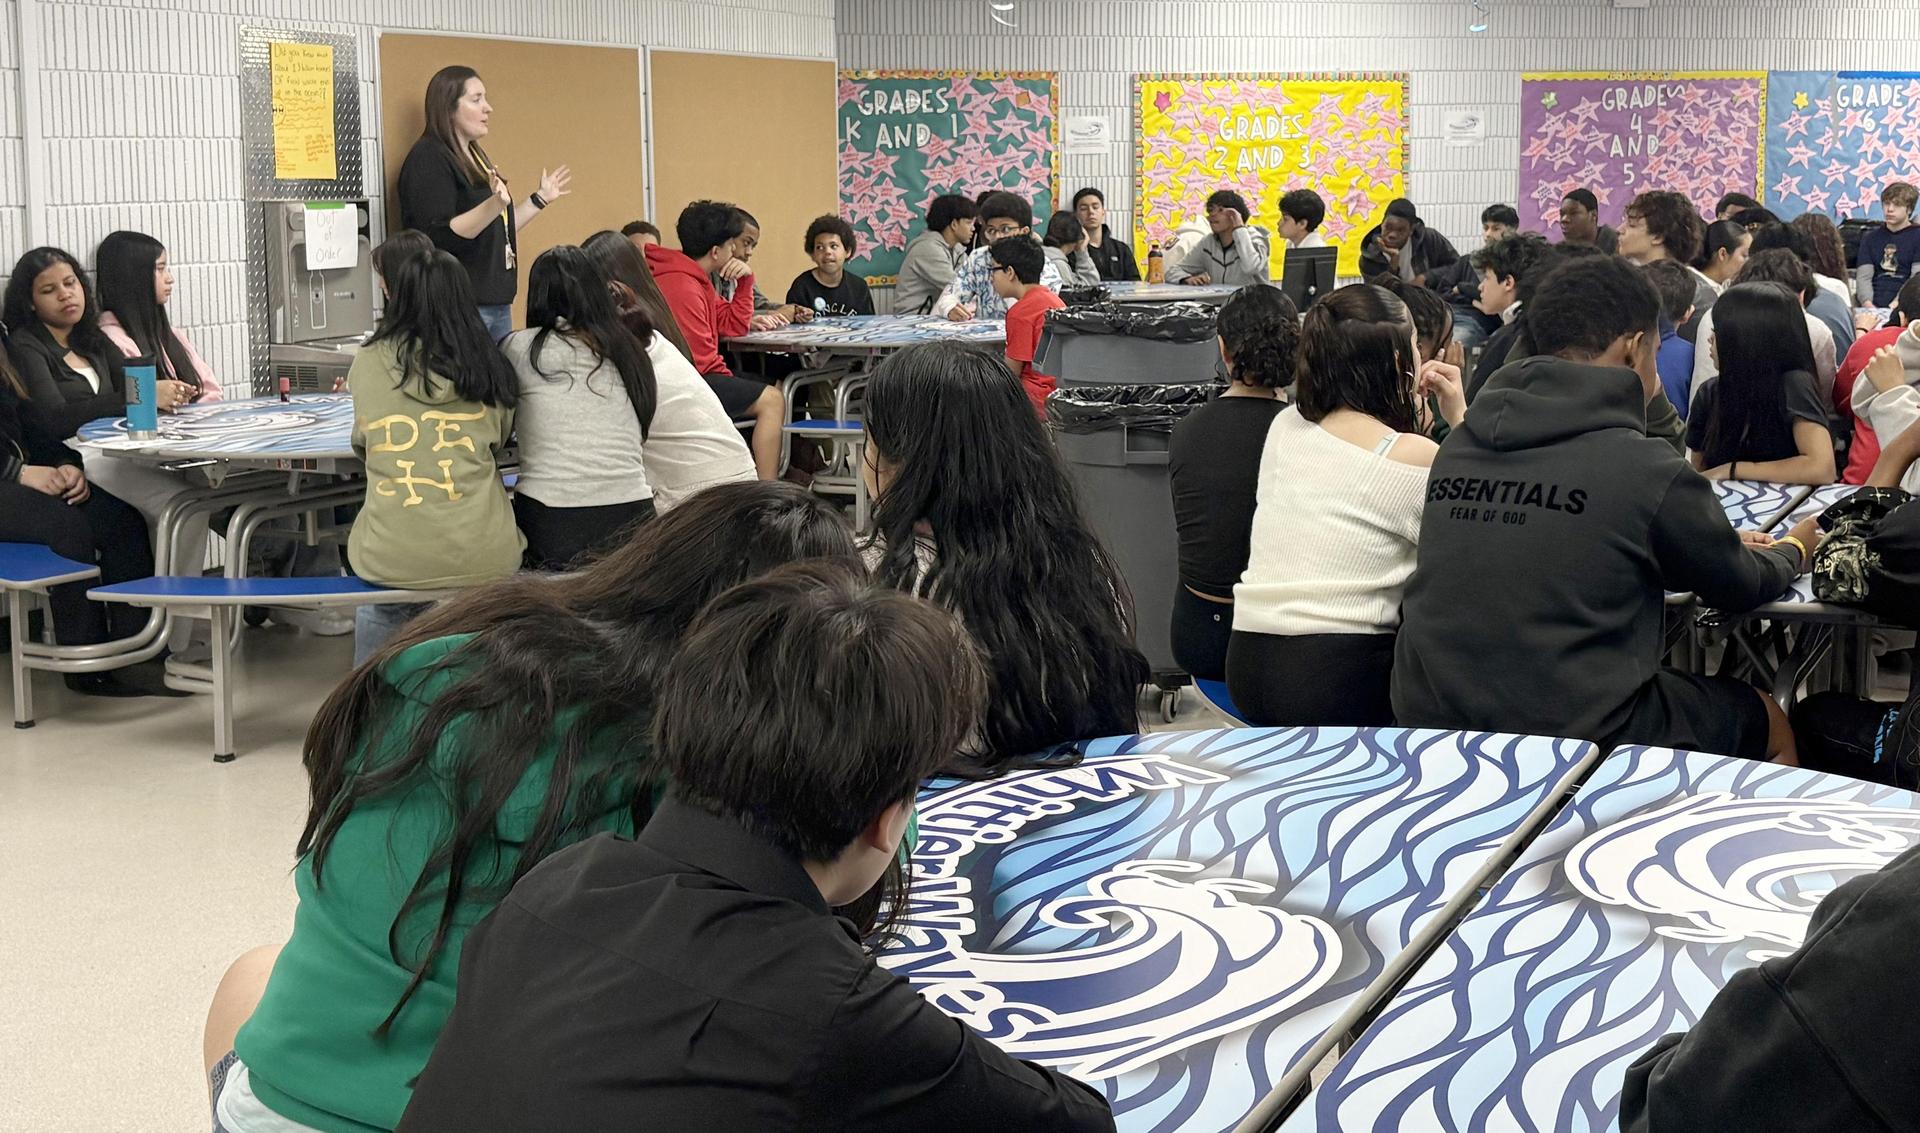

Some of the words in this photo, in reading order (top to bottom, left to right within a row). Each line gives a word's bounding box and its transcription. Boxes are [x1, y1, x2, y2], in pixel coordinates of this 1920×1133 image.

[857, 87, 949, 116] GRADES
[1601, 85, 1686, 112] GRADES
[1837, 83, 1904, 108] GRADE
[845, 116, 861, 143] K
[875, 123, 931, 149] AND
[951, 113, 958, 138] 1
[1219, 112, 1304, 141] GRADES
[1630, 112, 1642, 134] 4
[1863, 111, 1876, 132] 6
[1213, 146, 1229, 170] 2
[1236, 144, 1284, 172] AND
[1298, 144, 1311, 169] 3
[1609, 134, 1659, 158] AND
[1623, 162, 1635, 185] 5
[324, 225, 333, 241] of
[316, 246, 342, 263] Order
[1427, 477, 1588, 515] ESSENTIALS
[1450, 507, 1477, 521] FEAR
[1483, 510, 1497, 522] OF
[1503, 512, 1527, 526] GOD
[913, 758, 1222, 876] Whittier
